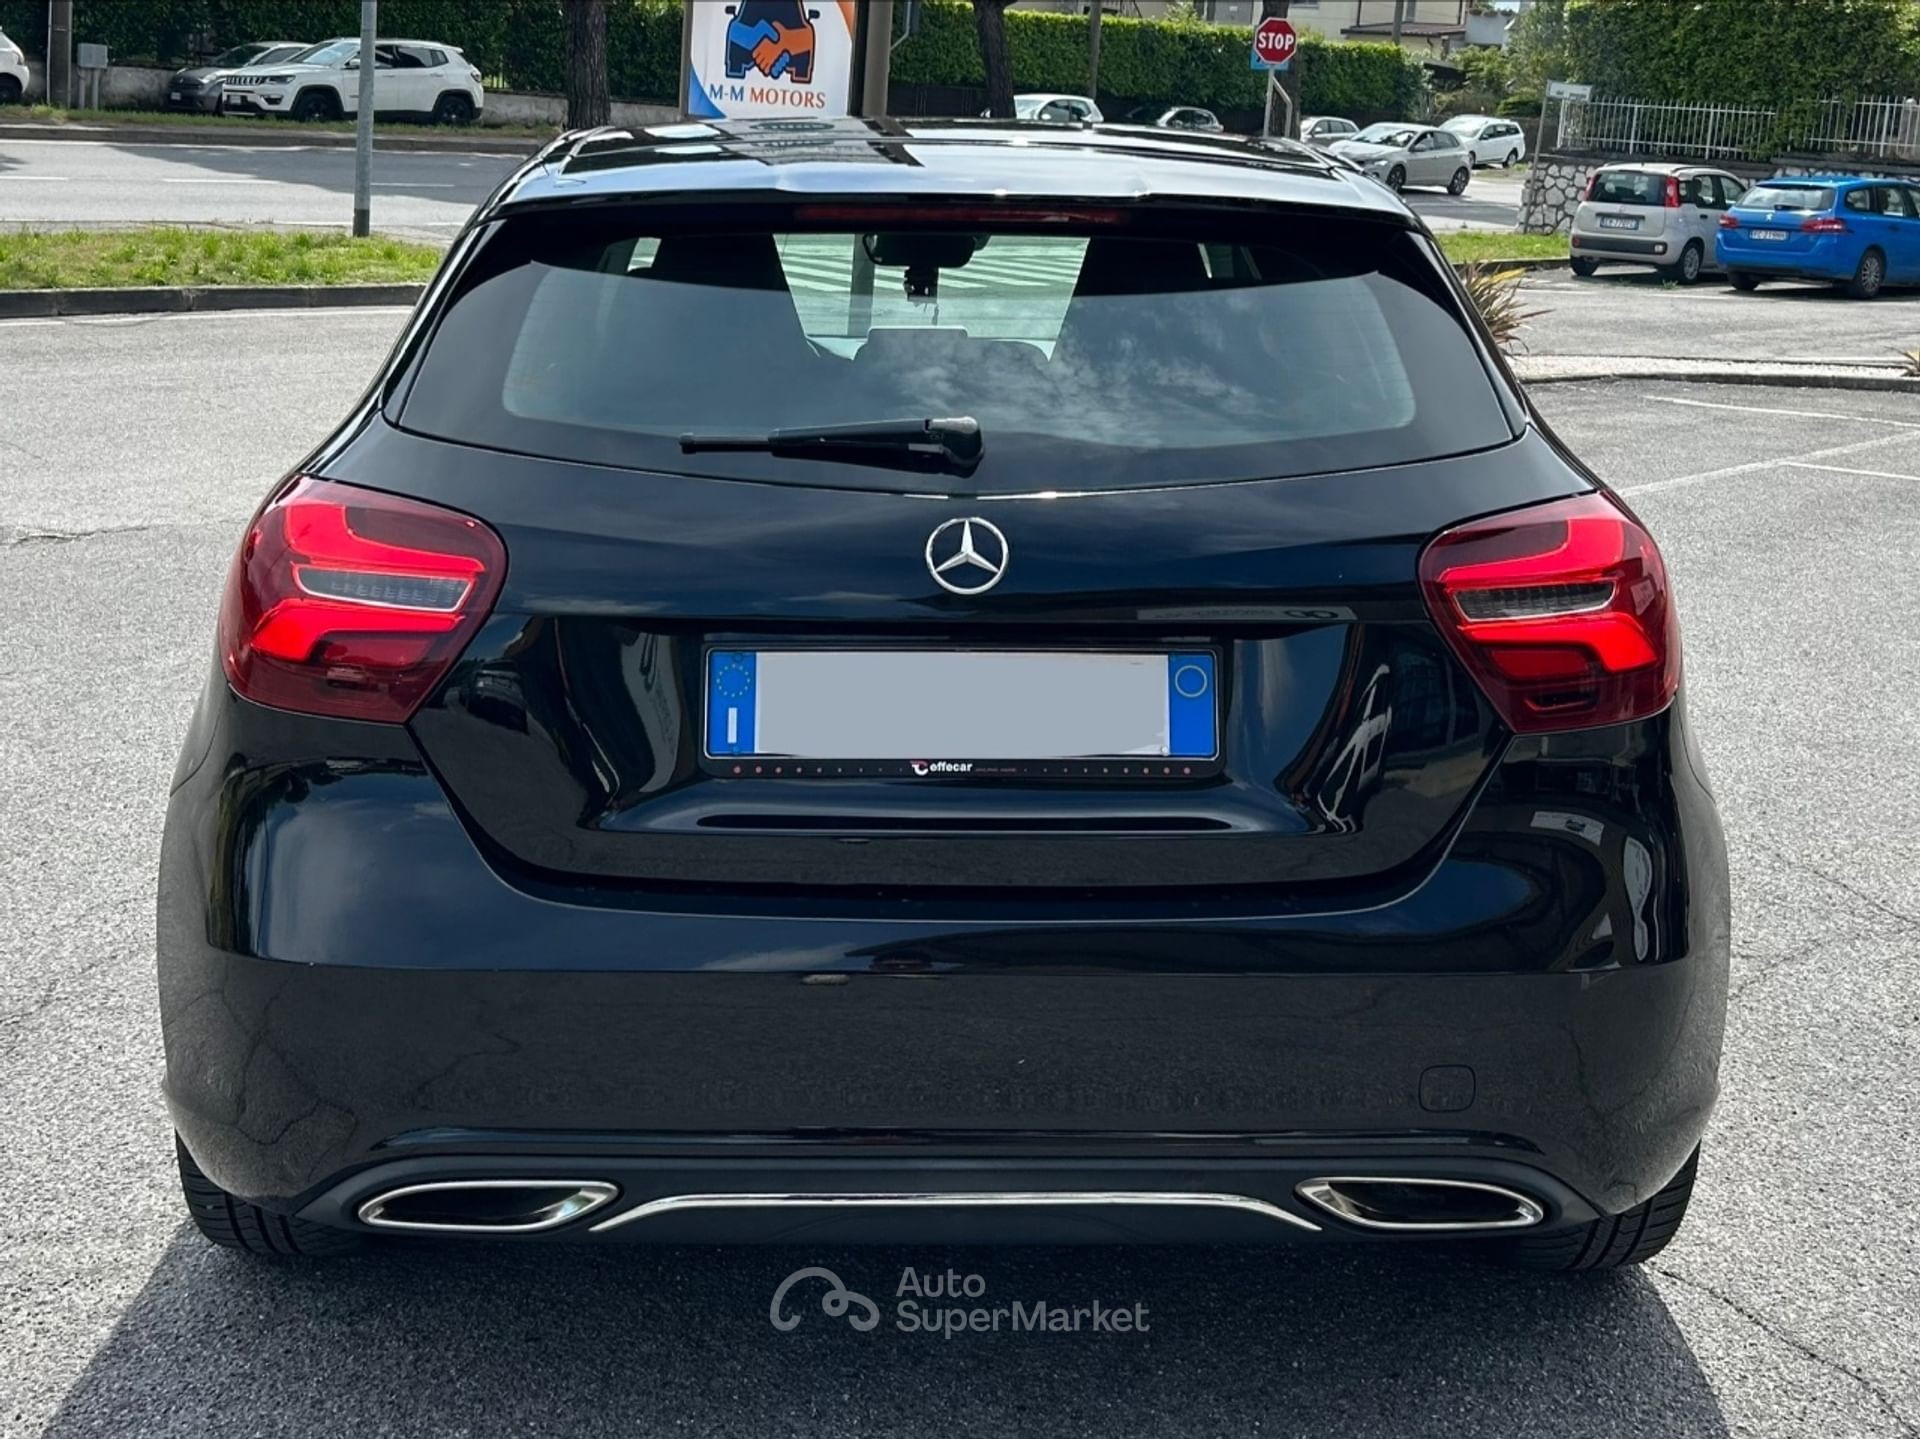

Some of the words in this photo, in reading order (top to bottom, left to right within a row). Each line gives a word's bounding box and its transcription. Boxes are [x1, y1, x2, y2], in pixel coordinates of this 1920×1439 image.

[1258, 32, 1295, 51] STOP
[709, 84, 744, 101] M-M
[750, 88, 826, 109] MOTORS
[929, 761, 973, 772] effecar
